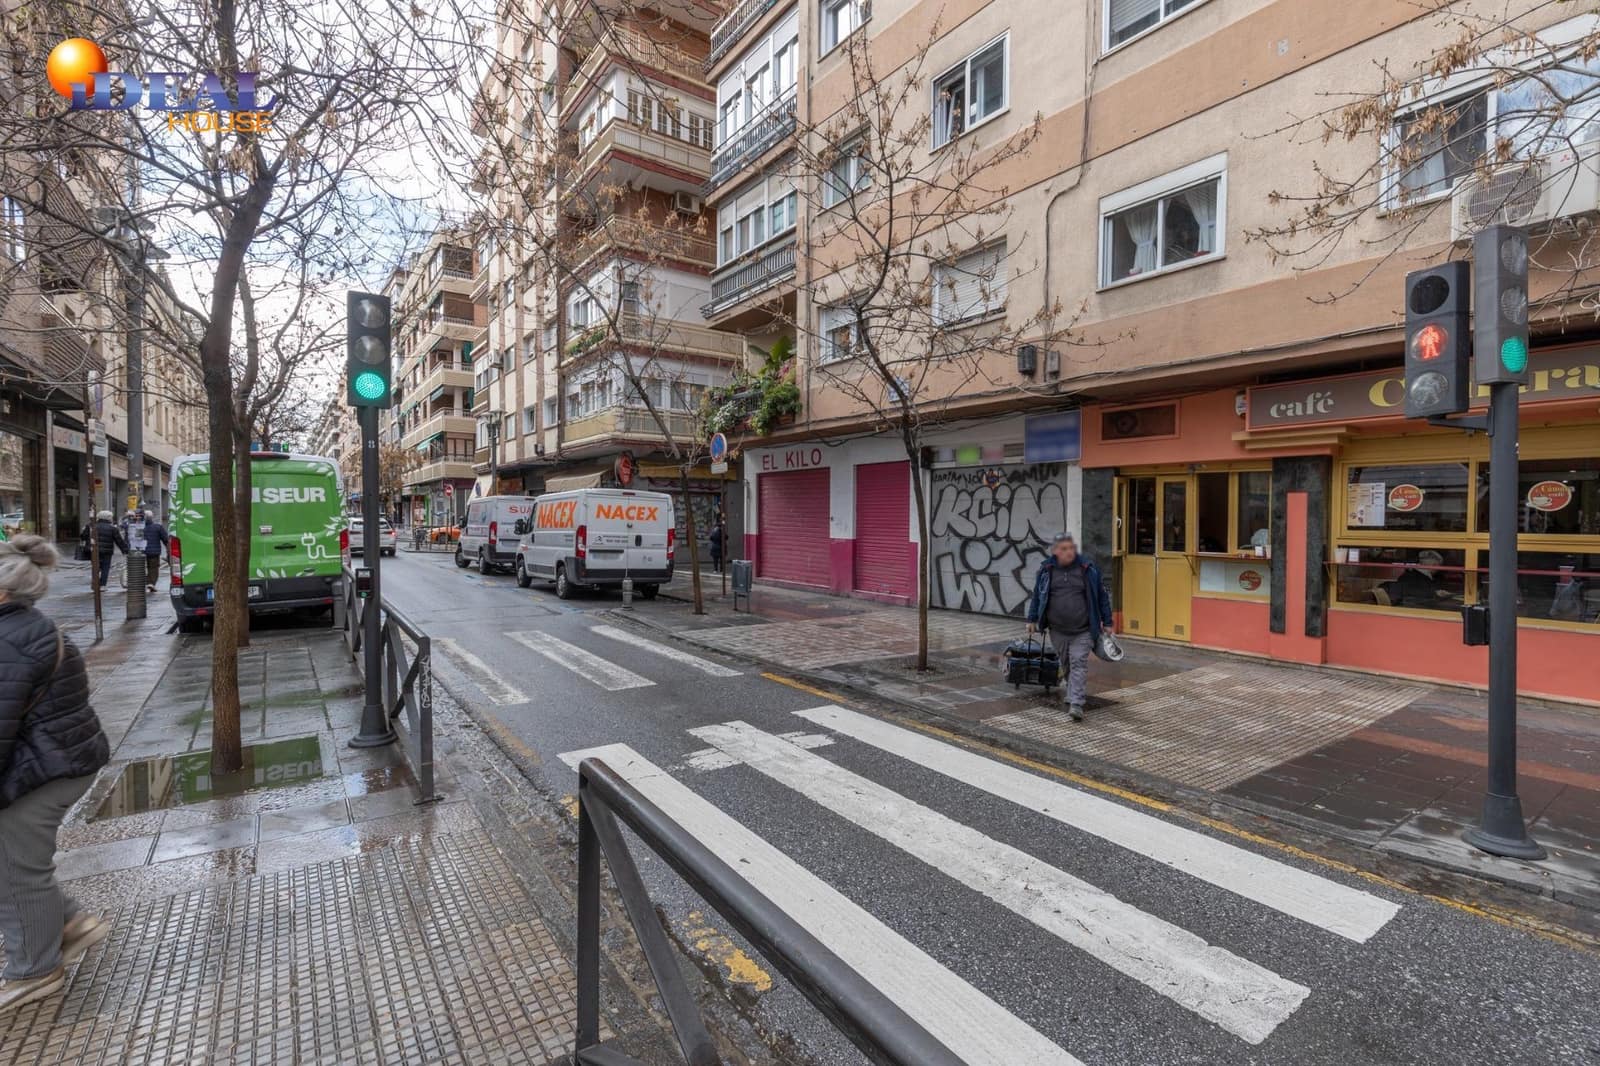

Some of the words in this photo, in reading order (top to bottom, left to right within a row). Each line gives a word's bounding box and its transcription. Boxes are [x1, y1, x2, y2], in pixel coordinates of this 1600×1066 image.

[1269, 391, 1334, 418] café
[762, 454, 778, 471] EL
[785, 448, 822, 468] KILO
[263, 487, 327, 504] SEUR
[537, 501, 578, 529] NACEX
[596, 503, 659, 521] NACEX
